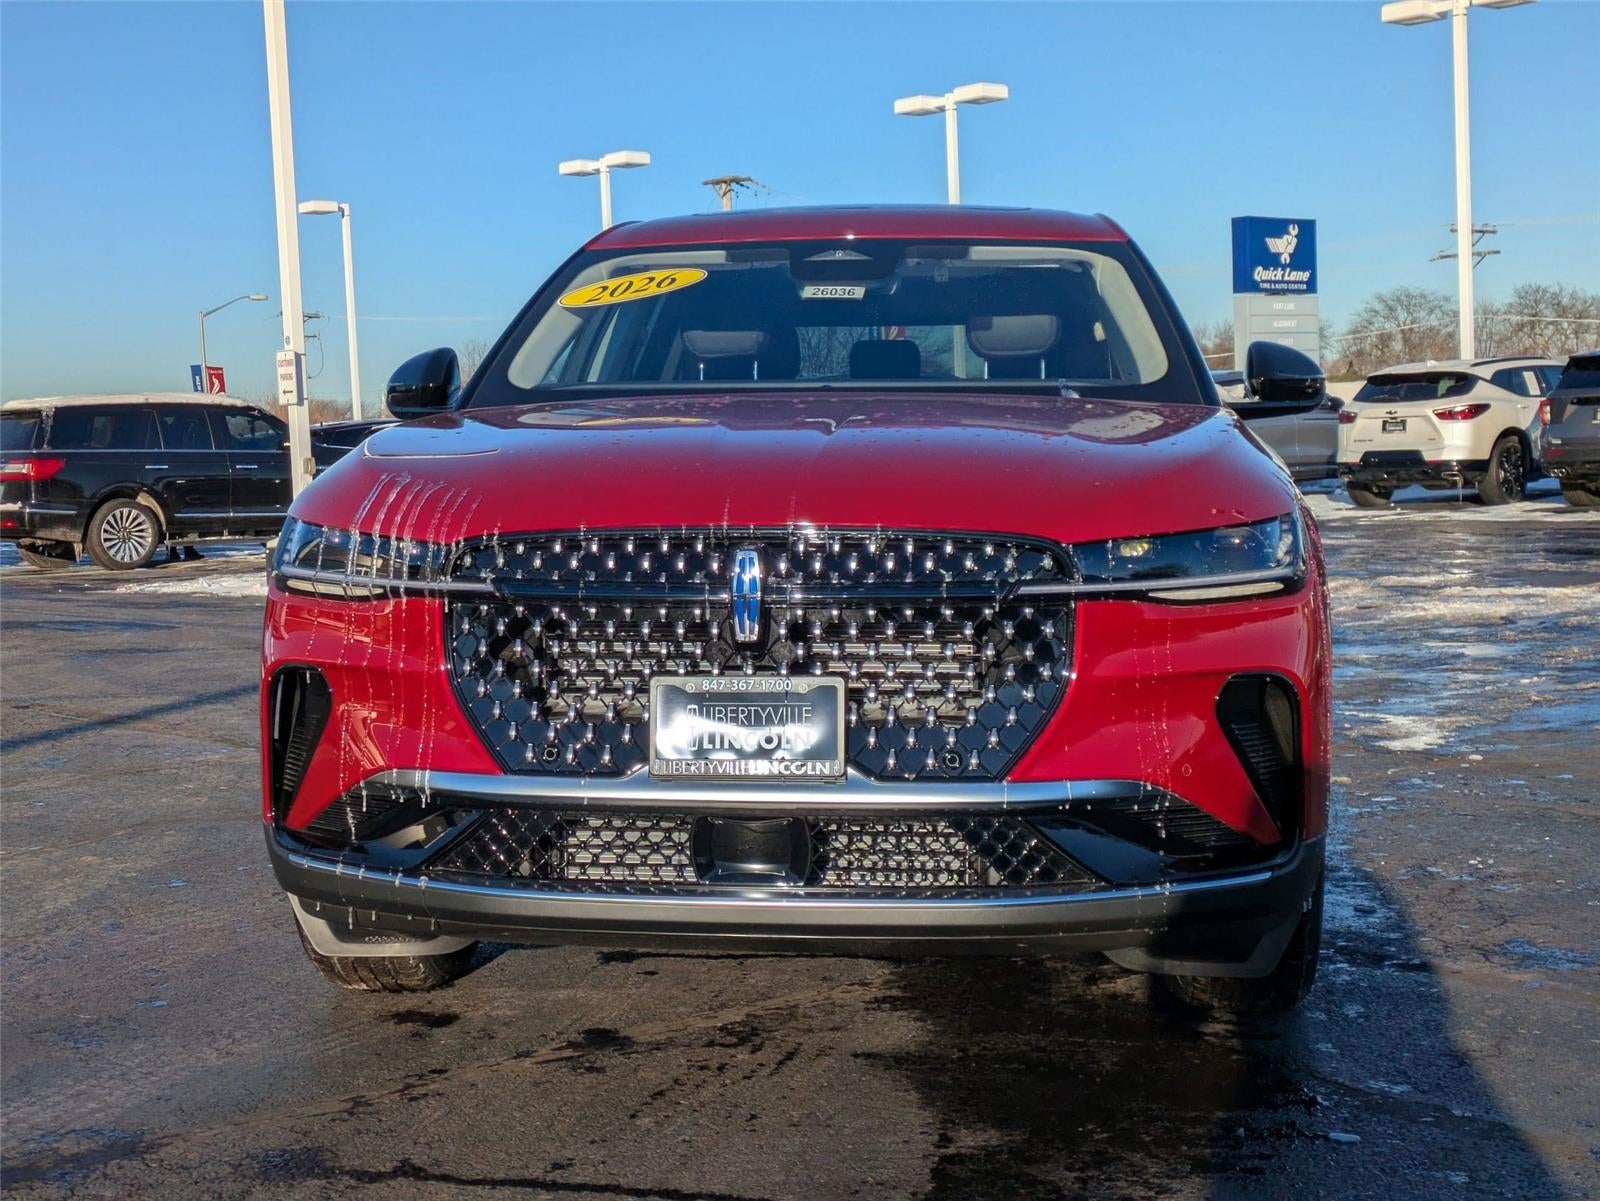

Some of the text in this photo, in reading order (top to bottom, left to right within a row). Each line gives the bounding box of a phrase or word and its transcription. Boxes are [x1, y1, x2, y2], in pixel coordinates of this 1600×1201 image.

[1254, 266, 1310, 281] Quick Lane
[584, 271, 680, 304] 2026
[811, 287, 856, 296] 26036
[702, 680, 792, 691] 847-367-1700
[703, 706, 812, 725] LIBERTYVILLE
[703, 731, 811, 749] LINCOLN
